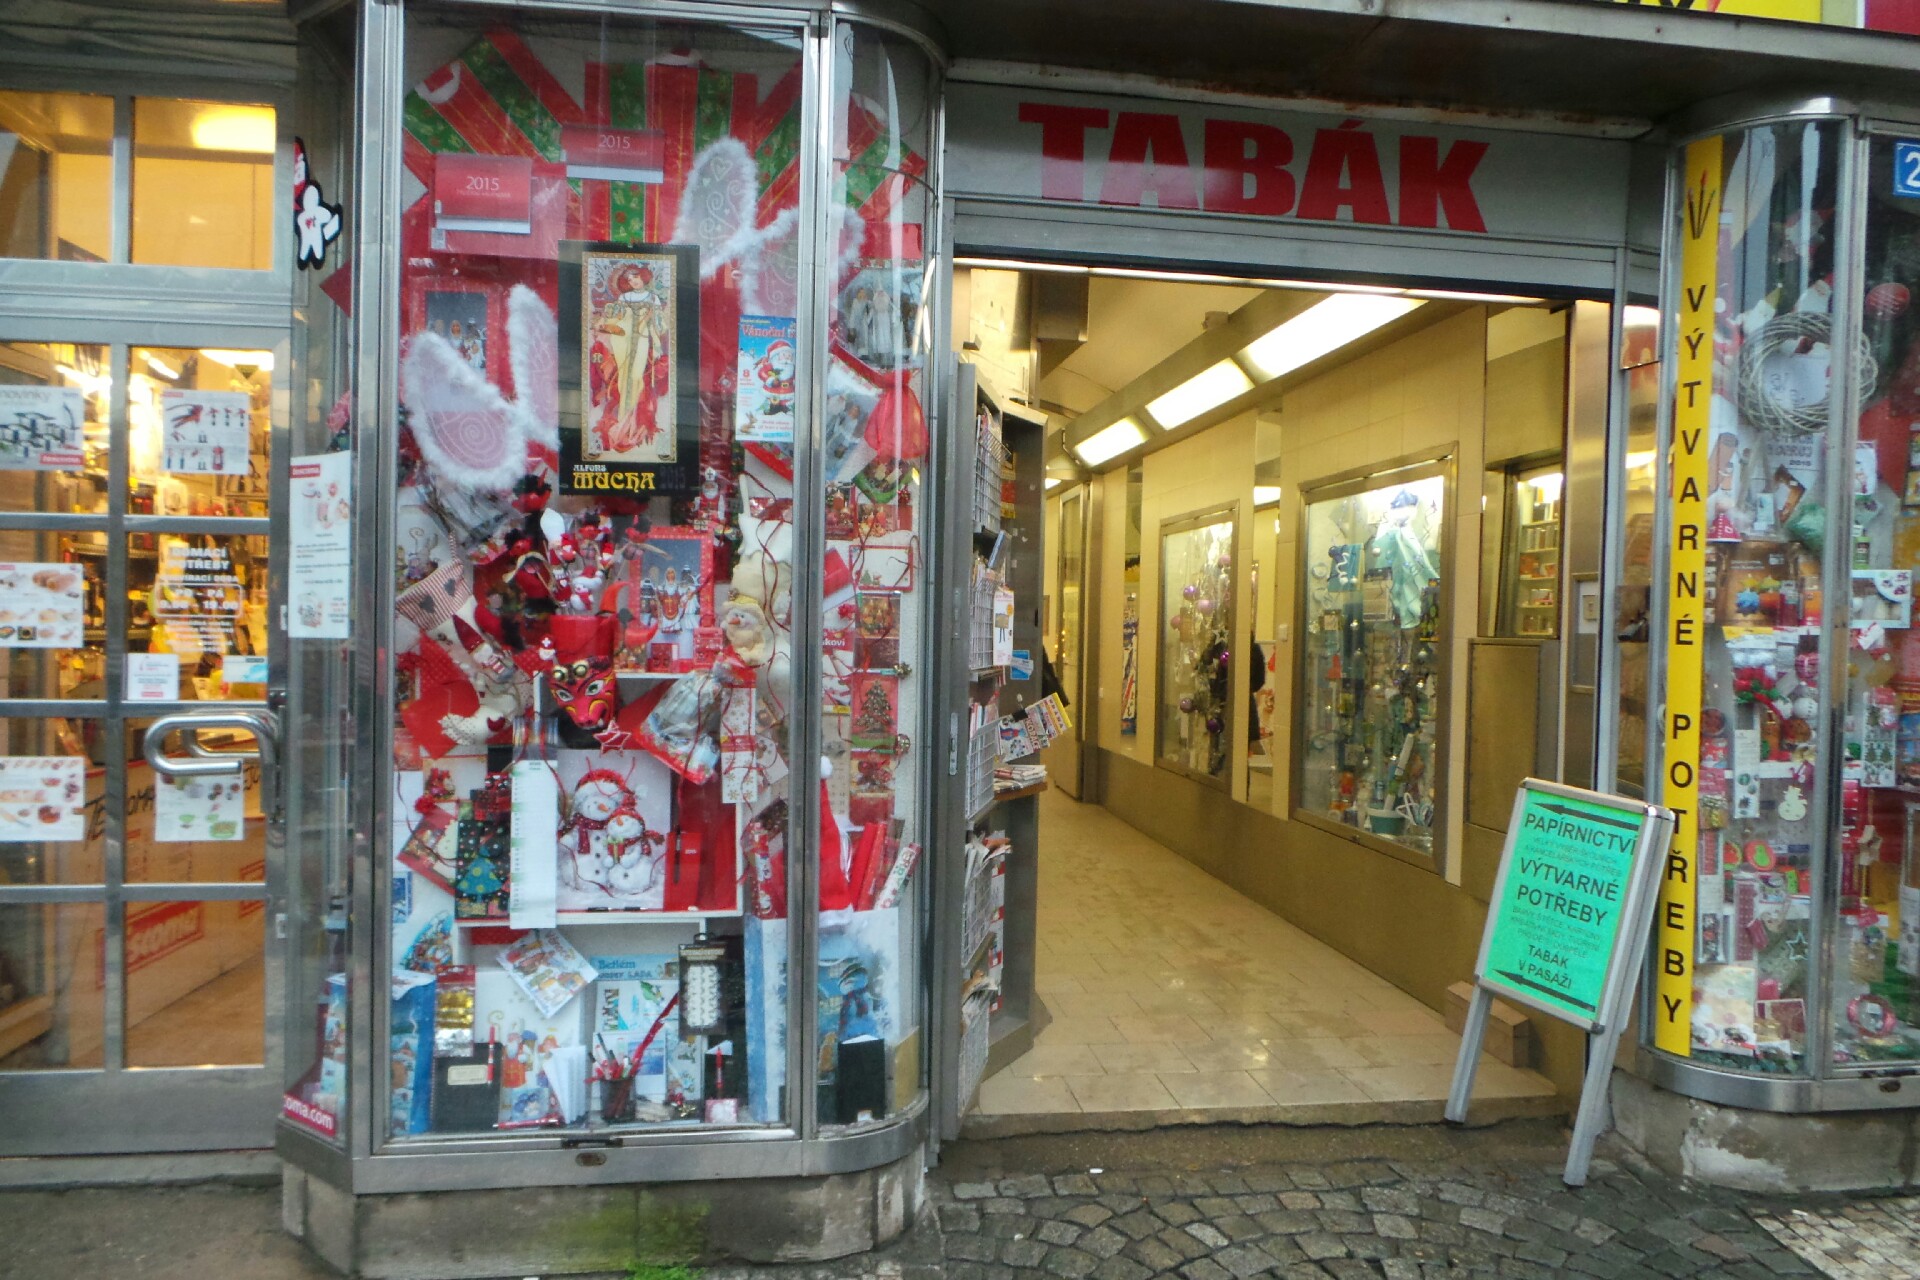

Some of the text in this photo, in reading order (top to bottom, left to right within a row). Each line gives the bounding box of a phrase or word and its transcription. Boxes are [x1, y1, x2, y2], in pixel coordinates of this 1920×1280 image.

[598, 134, 631, 149] 2015
[465, 176, 500, 191] 2015
[1019, 102, 1490, 233] TABÁK
[573, 465, 687, 493] MUCHA 2015
[1662, 285, 1706, 1023] VÝTVARNÉ POTŘEBY
[1524, 812, 1638, 856] PAPÍRNICTVÍ
[1520, 857, 1619, 901] VÝTVARNÉ
[1517, 885, 1608, 926] POTŘEBY
[1519, 960, 1527, 972] V
[1528, 944, 1569, 969] TABÁK
